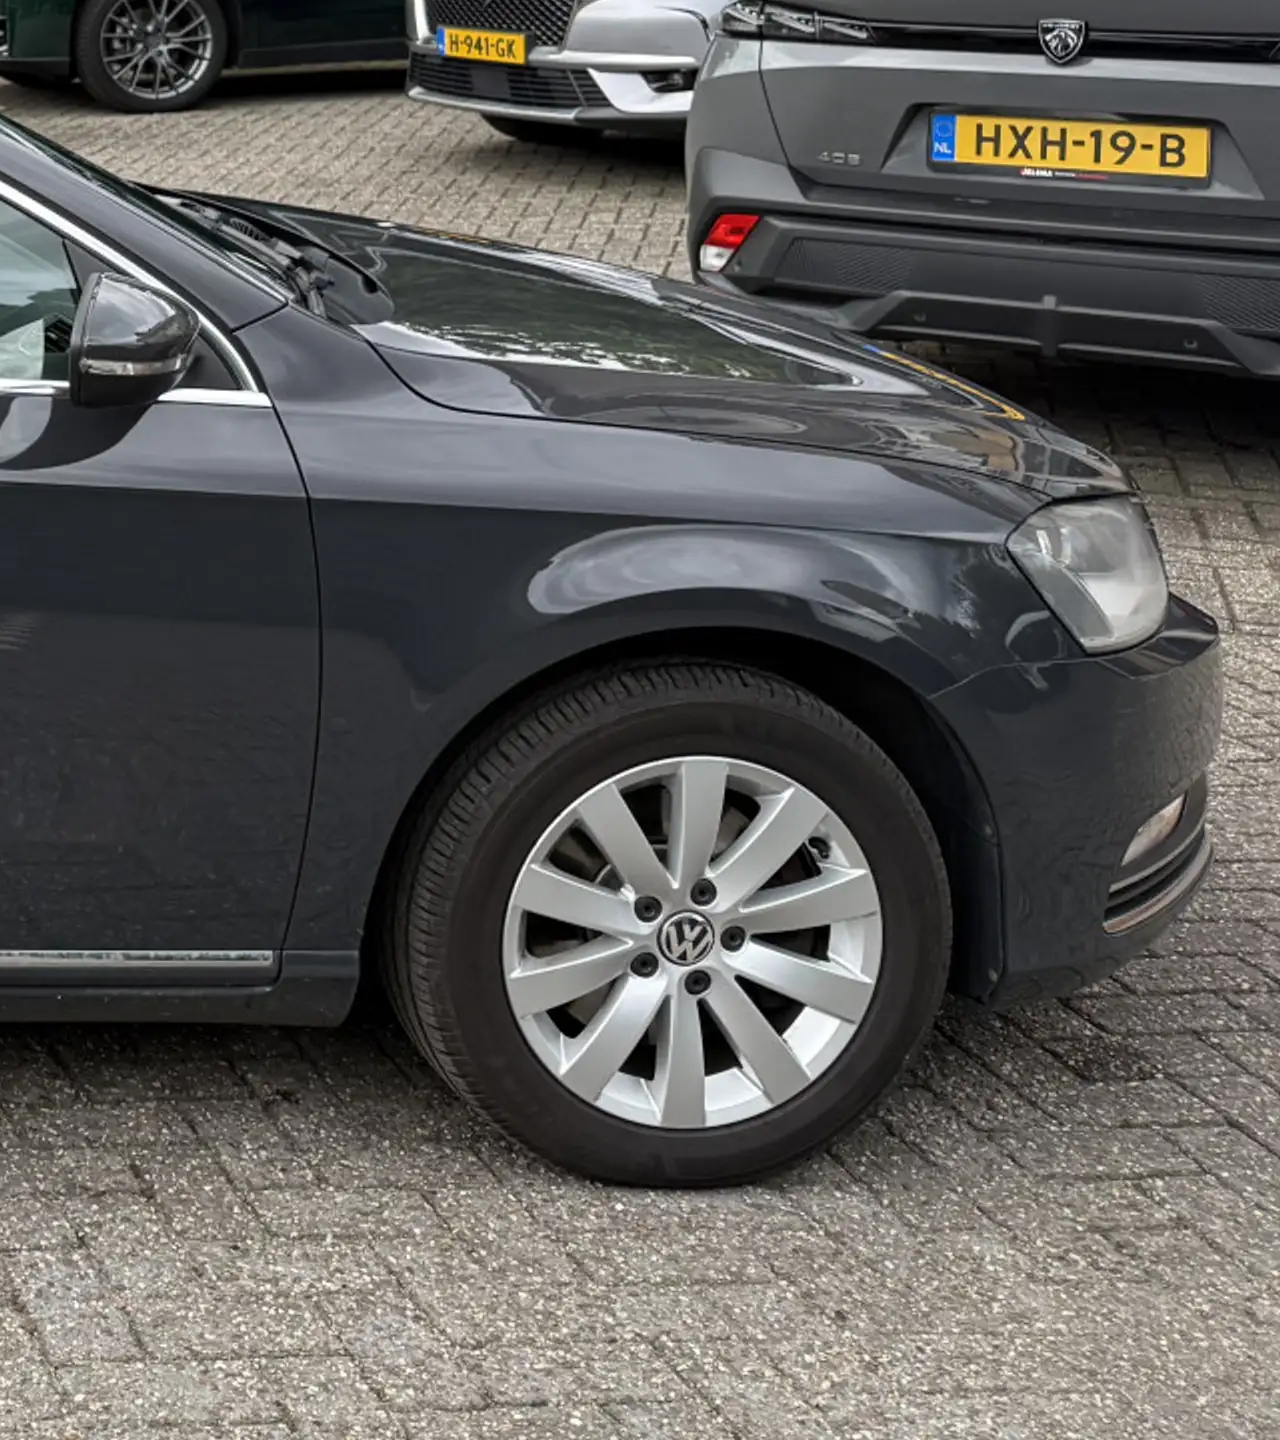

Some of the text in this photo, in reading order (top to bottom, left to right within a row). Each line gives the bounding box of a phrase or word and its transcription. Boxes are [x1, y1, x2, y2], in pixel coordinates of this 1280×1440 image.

[450, 33, 516, 58] H-941-GK
[934, 123, 1186, 169] NL HXH-19-B
